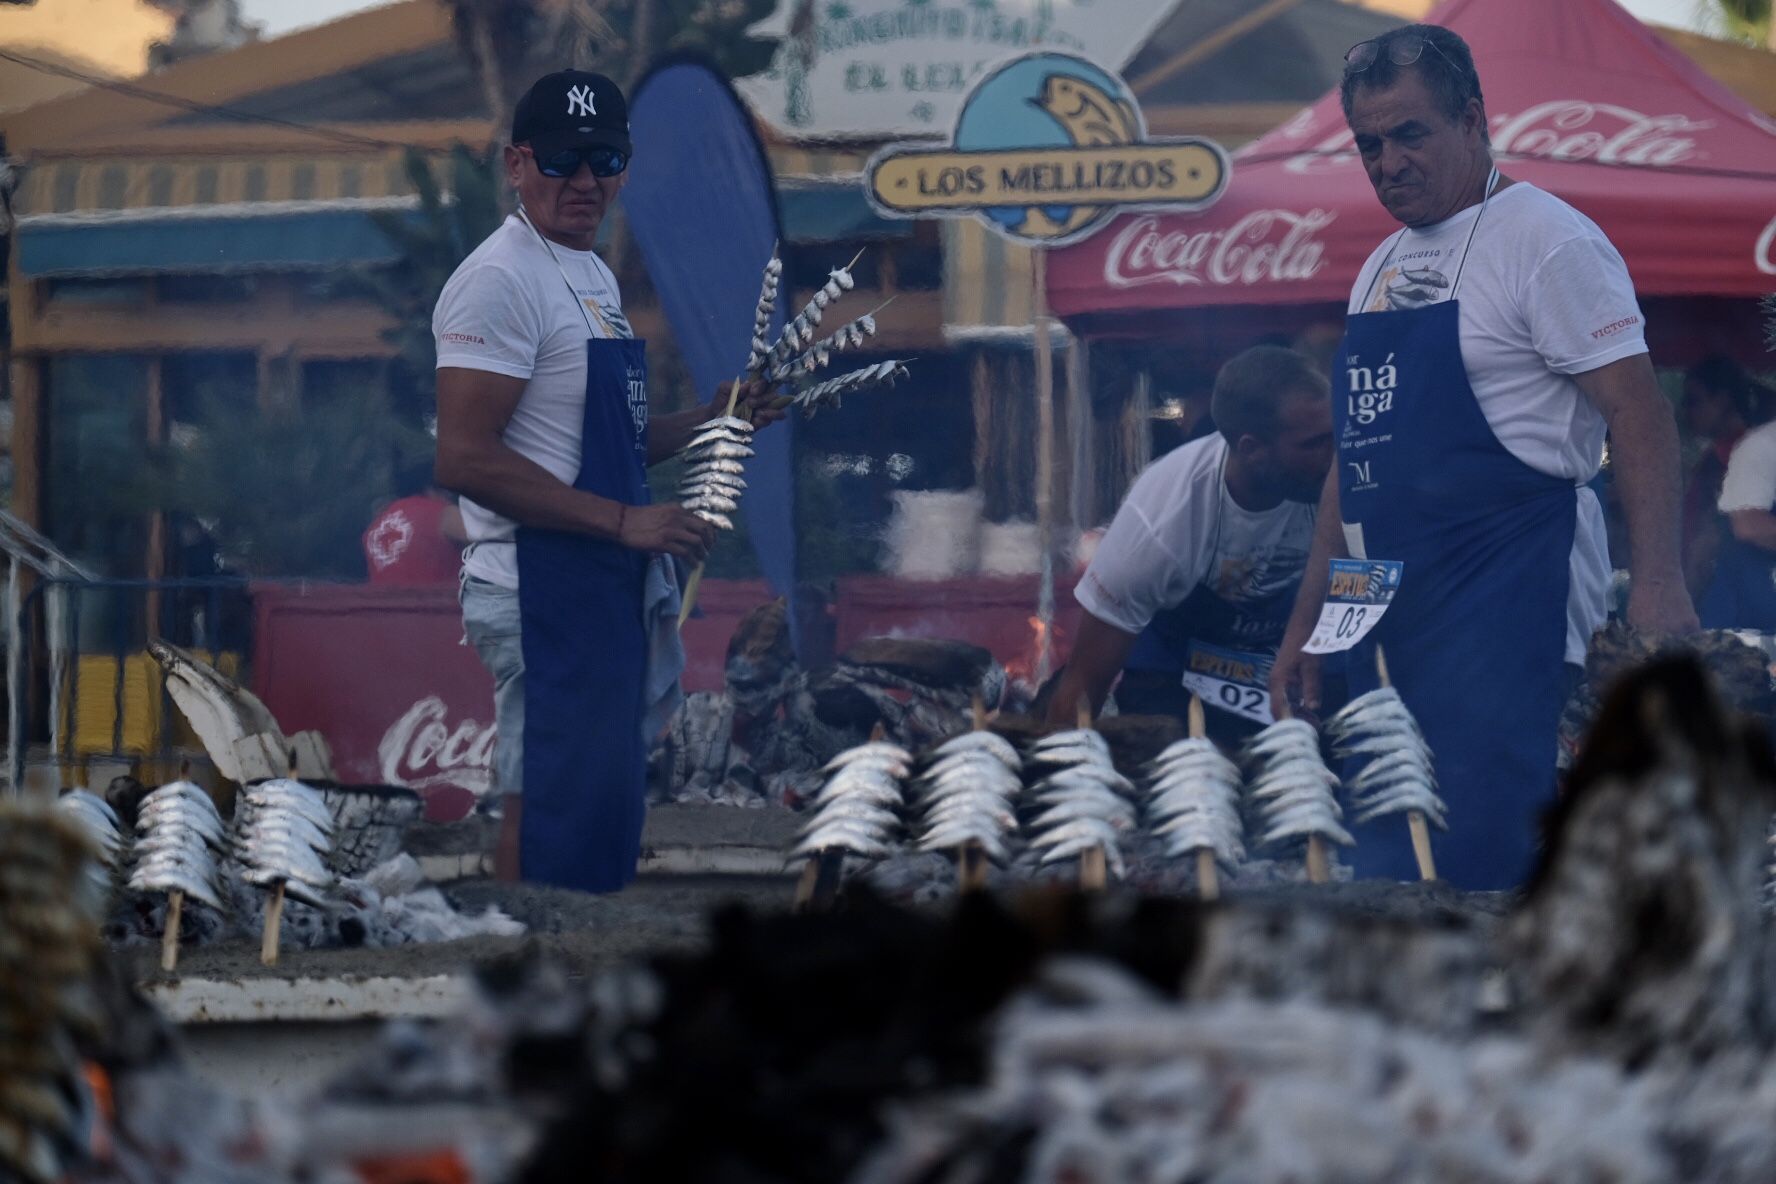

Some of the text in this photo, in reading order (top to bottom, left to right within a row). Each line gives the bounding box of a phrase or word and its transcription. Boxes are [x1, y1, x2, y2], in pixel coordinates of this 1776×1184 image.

[567, 85, 597, 116] NY
[917, 158, 1176, 196] LOS MELLIZOS
[1398, 249, 1441, 262] CONCURSO
[441, 333, 486, 345] VICTORIA
[1591, 315, 1639, 339] VICTORIA
[1336, 606, 1367, 639] 03
[1220, 684, 1264, 715] 02
